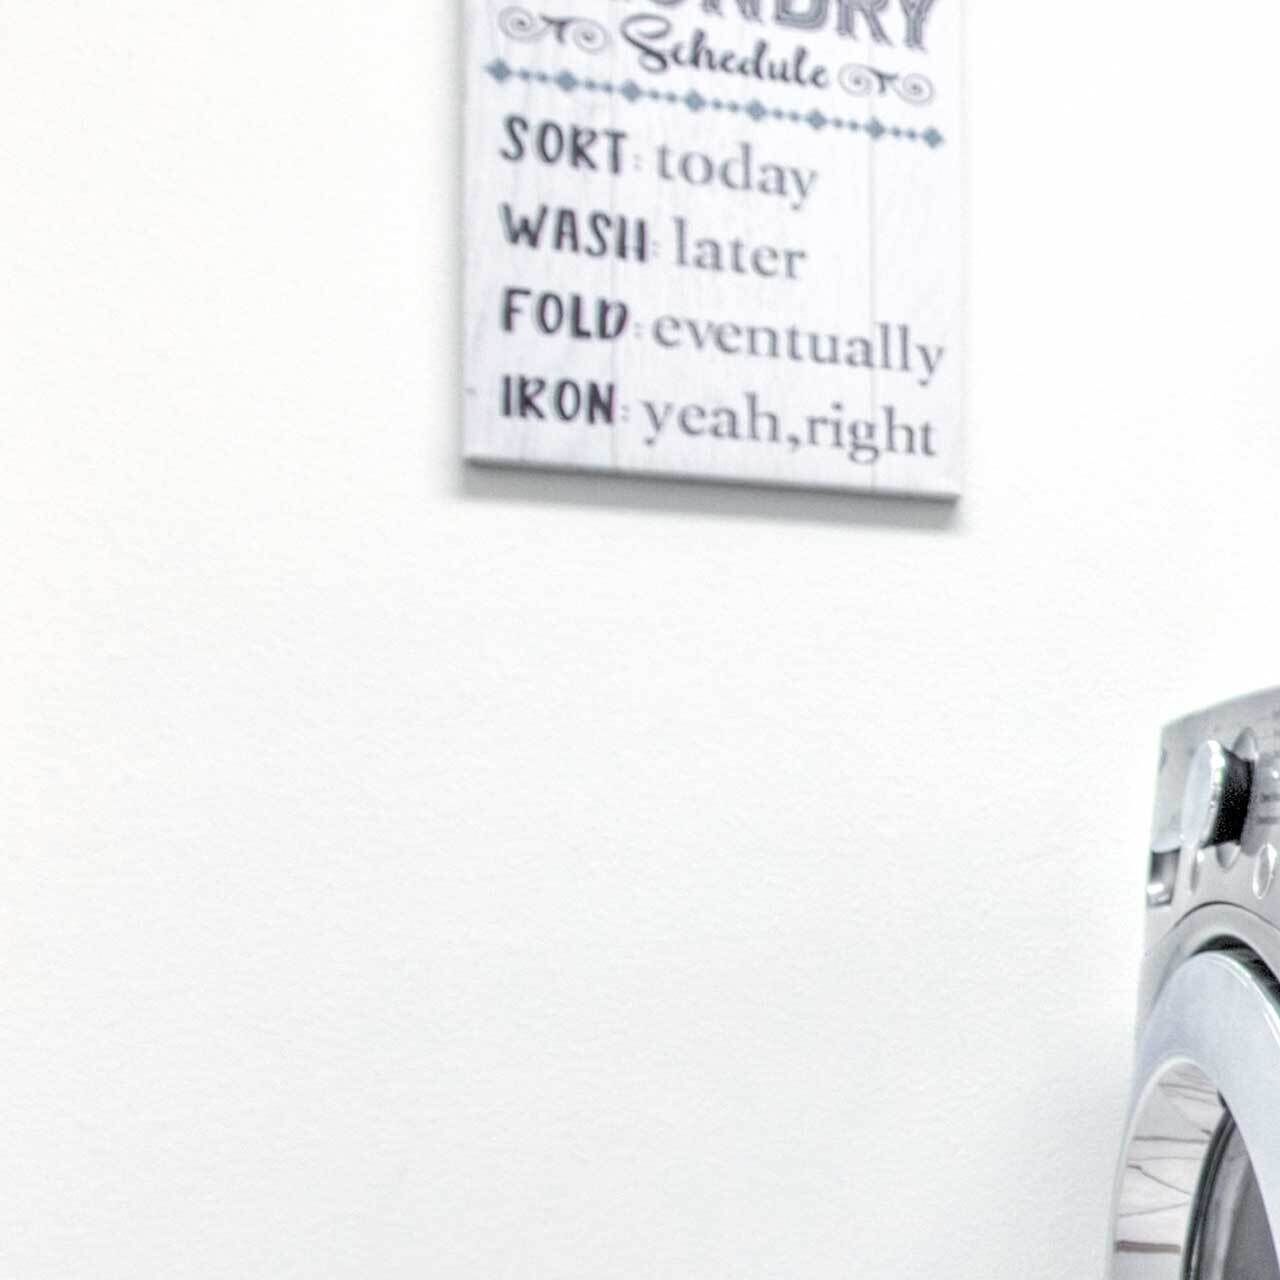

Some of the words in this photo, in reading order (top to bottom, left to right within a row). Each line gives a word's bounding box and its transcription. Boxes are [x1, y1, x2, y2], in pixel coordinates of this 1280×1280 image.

[621, 13, 828, 90] Schedule
[656, 142, 818, 211] today
[673, 217, 808, 281] later
[652, 315, 946, 388] eventually
